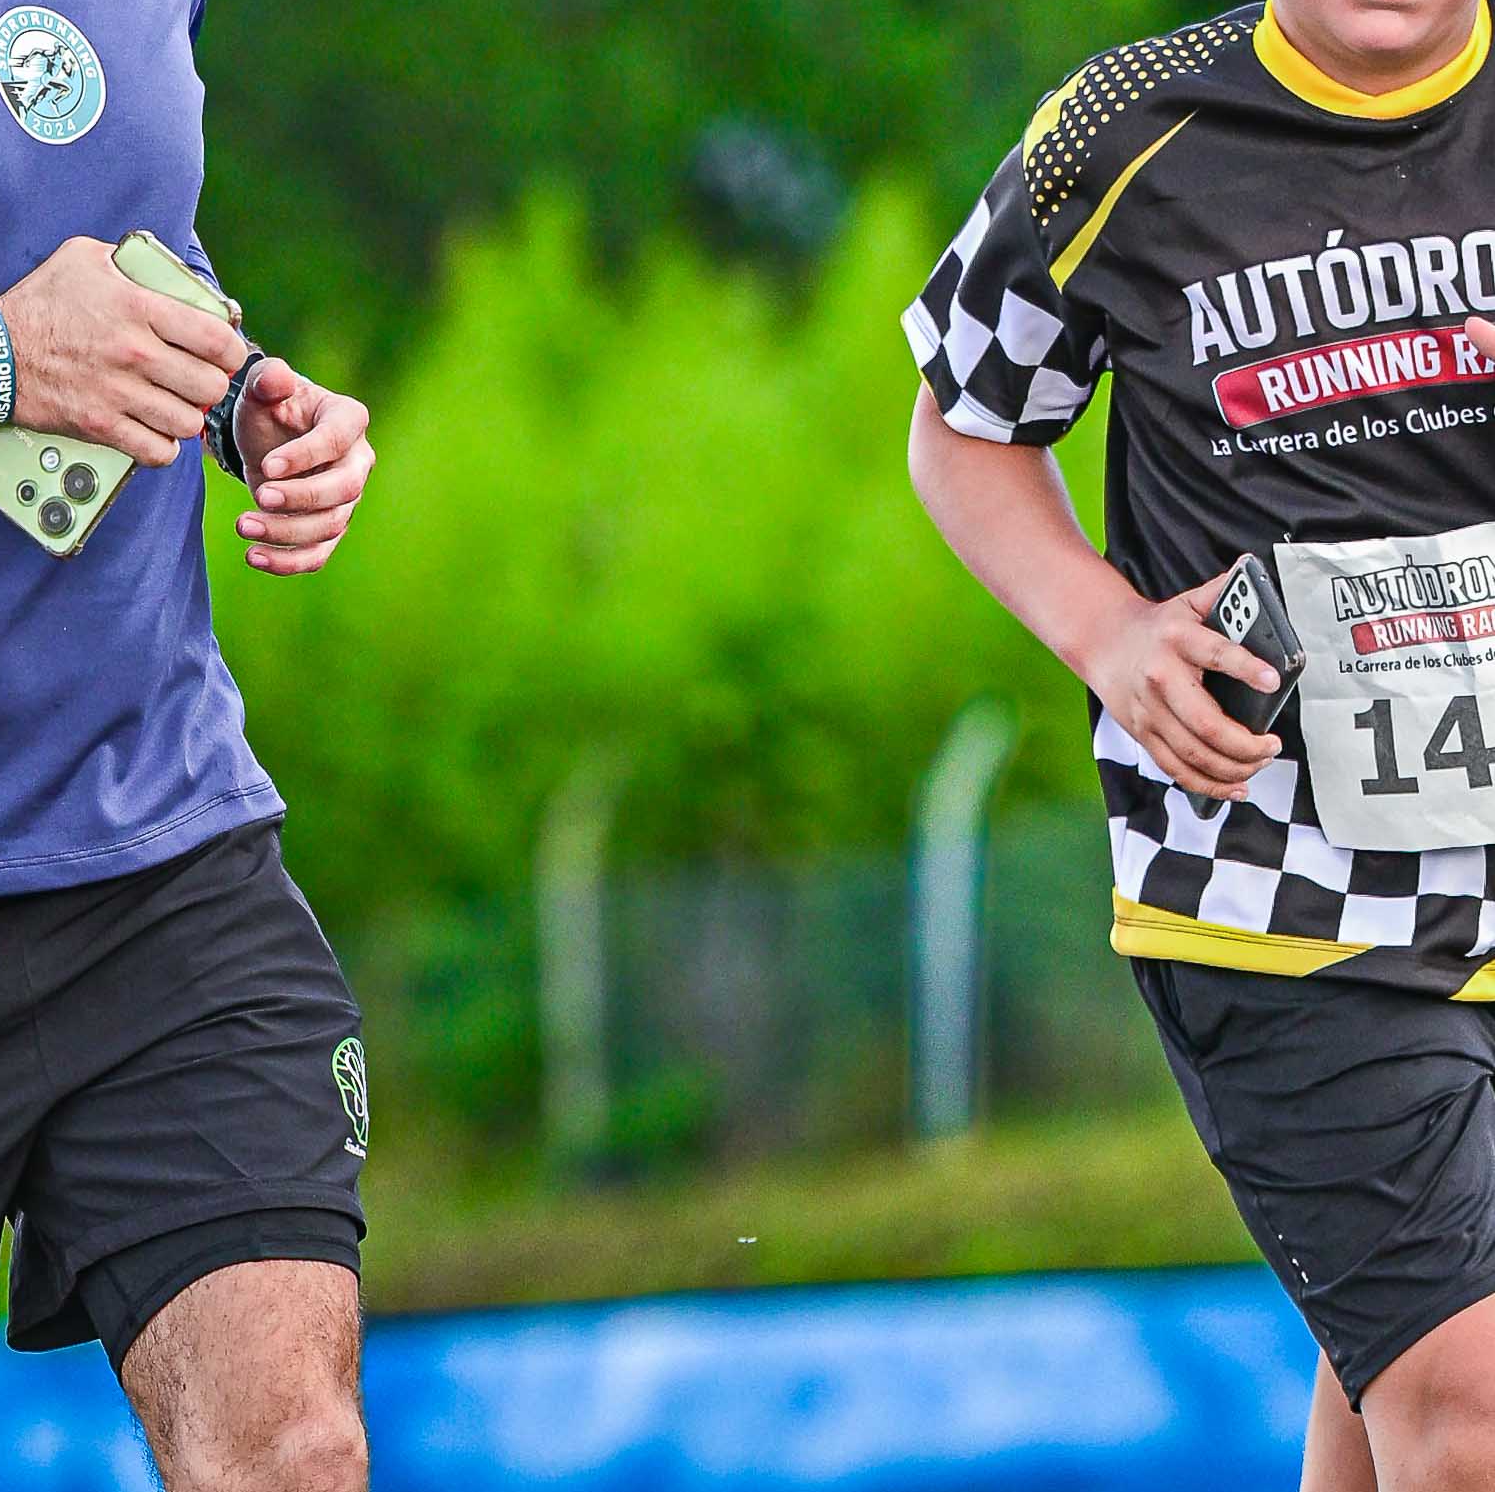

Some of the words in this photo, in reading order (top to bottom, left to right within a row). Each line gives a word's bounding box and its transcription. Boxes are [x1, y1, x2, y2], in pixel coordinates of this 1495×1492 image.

[32, 118, 77, 137] 2024
[1256, 334, 1442, 412] RUNNING
[1325, 420, 1358, 447] de
[1362, 415, 1400, 440] los
[1405, 404, 1487, 434] Clubes
[1371, 615, 1458, 649] RUNNING
[1339, 660, 1353, 673] La
[1355, 660, 1401, 673] Carrera
[1405, 656, 1420, 669] de
[1423, 654, 1442, 668] los
[1444, 652, 1483, 668] Clubes
